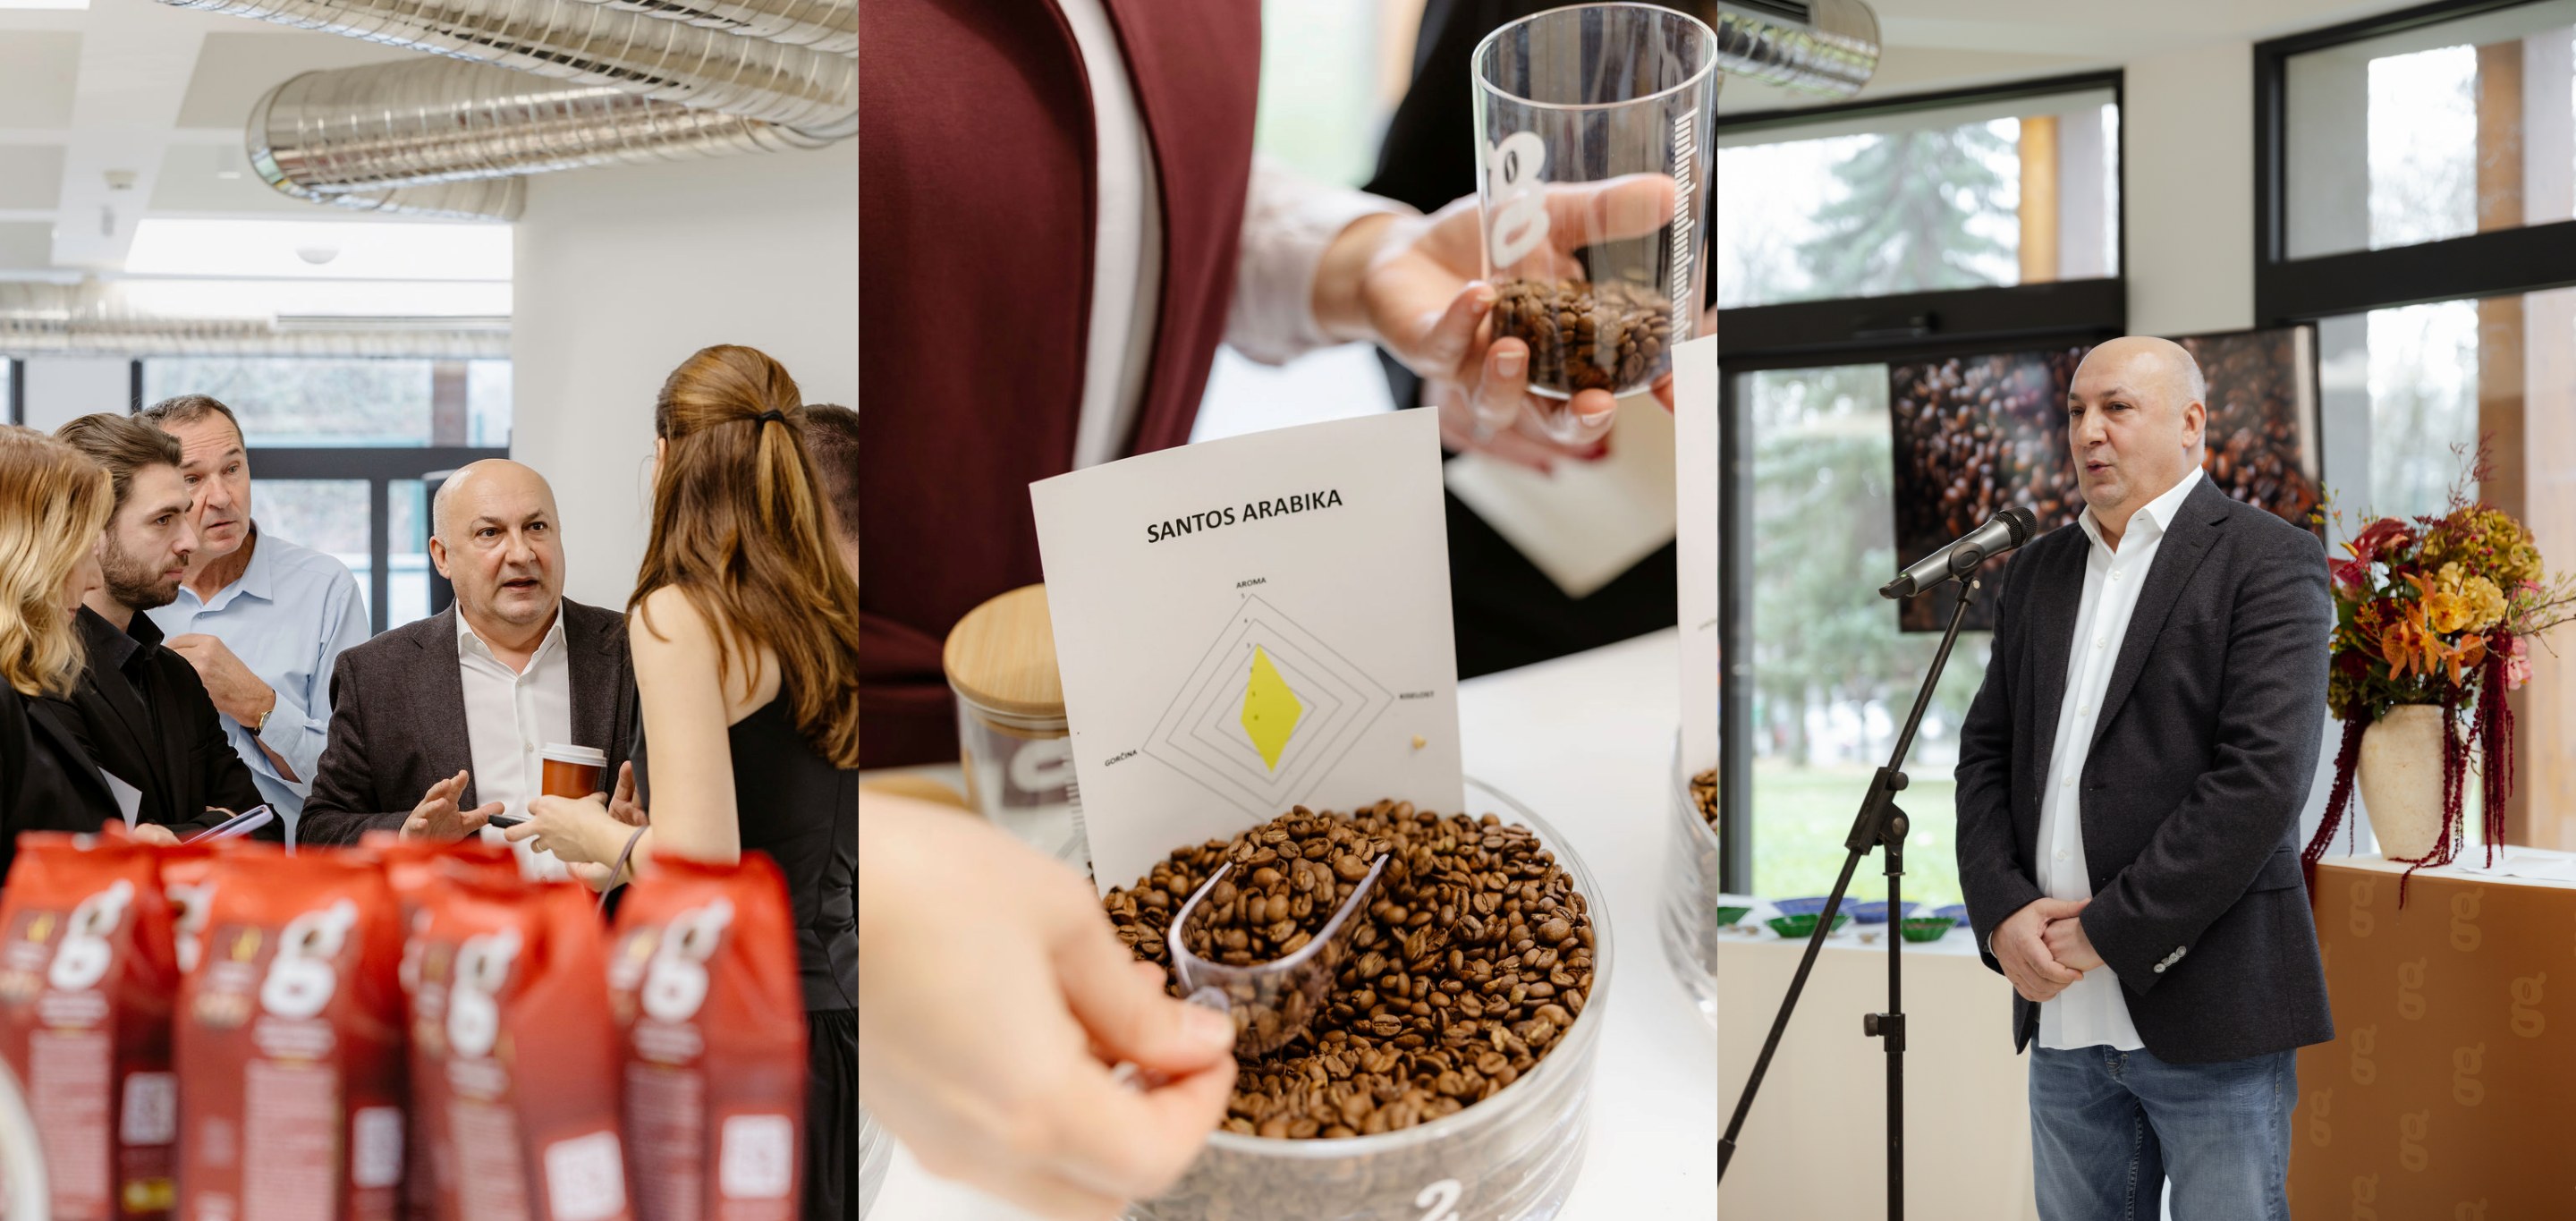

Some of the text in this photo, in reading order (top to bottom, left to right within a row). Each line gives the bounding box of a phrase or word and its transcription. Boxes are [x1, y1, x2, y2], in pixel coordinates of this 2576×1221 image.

[1147, 488, 1343, 544] SANTOS ARABIKA
[1235, 576, 1267, 589] AROMA
[1105, 749, 1138, 767] GORČINA
